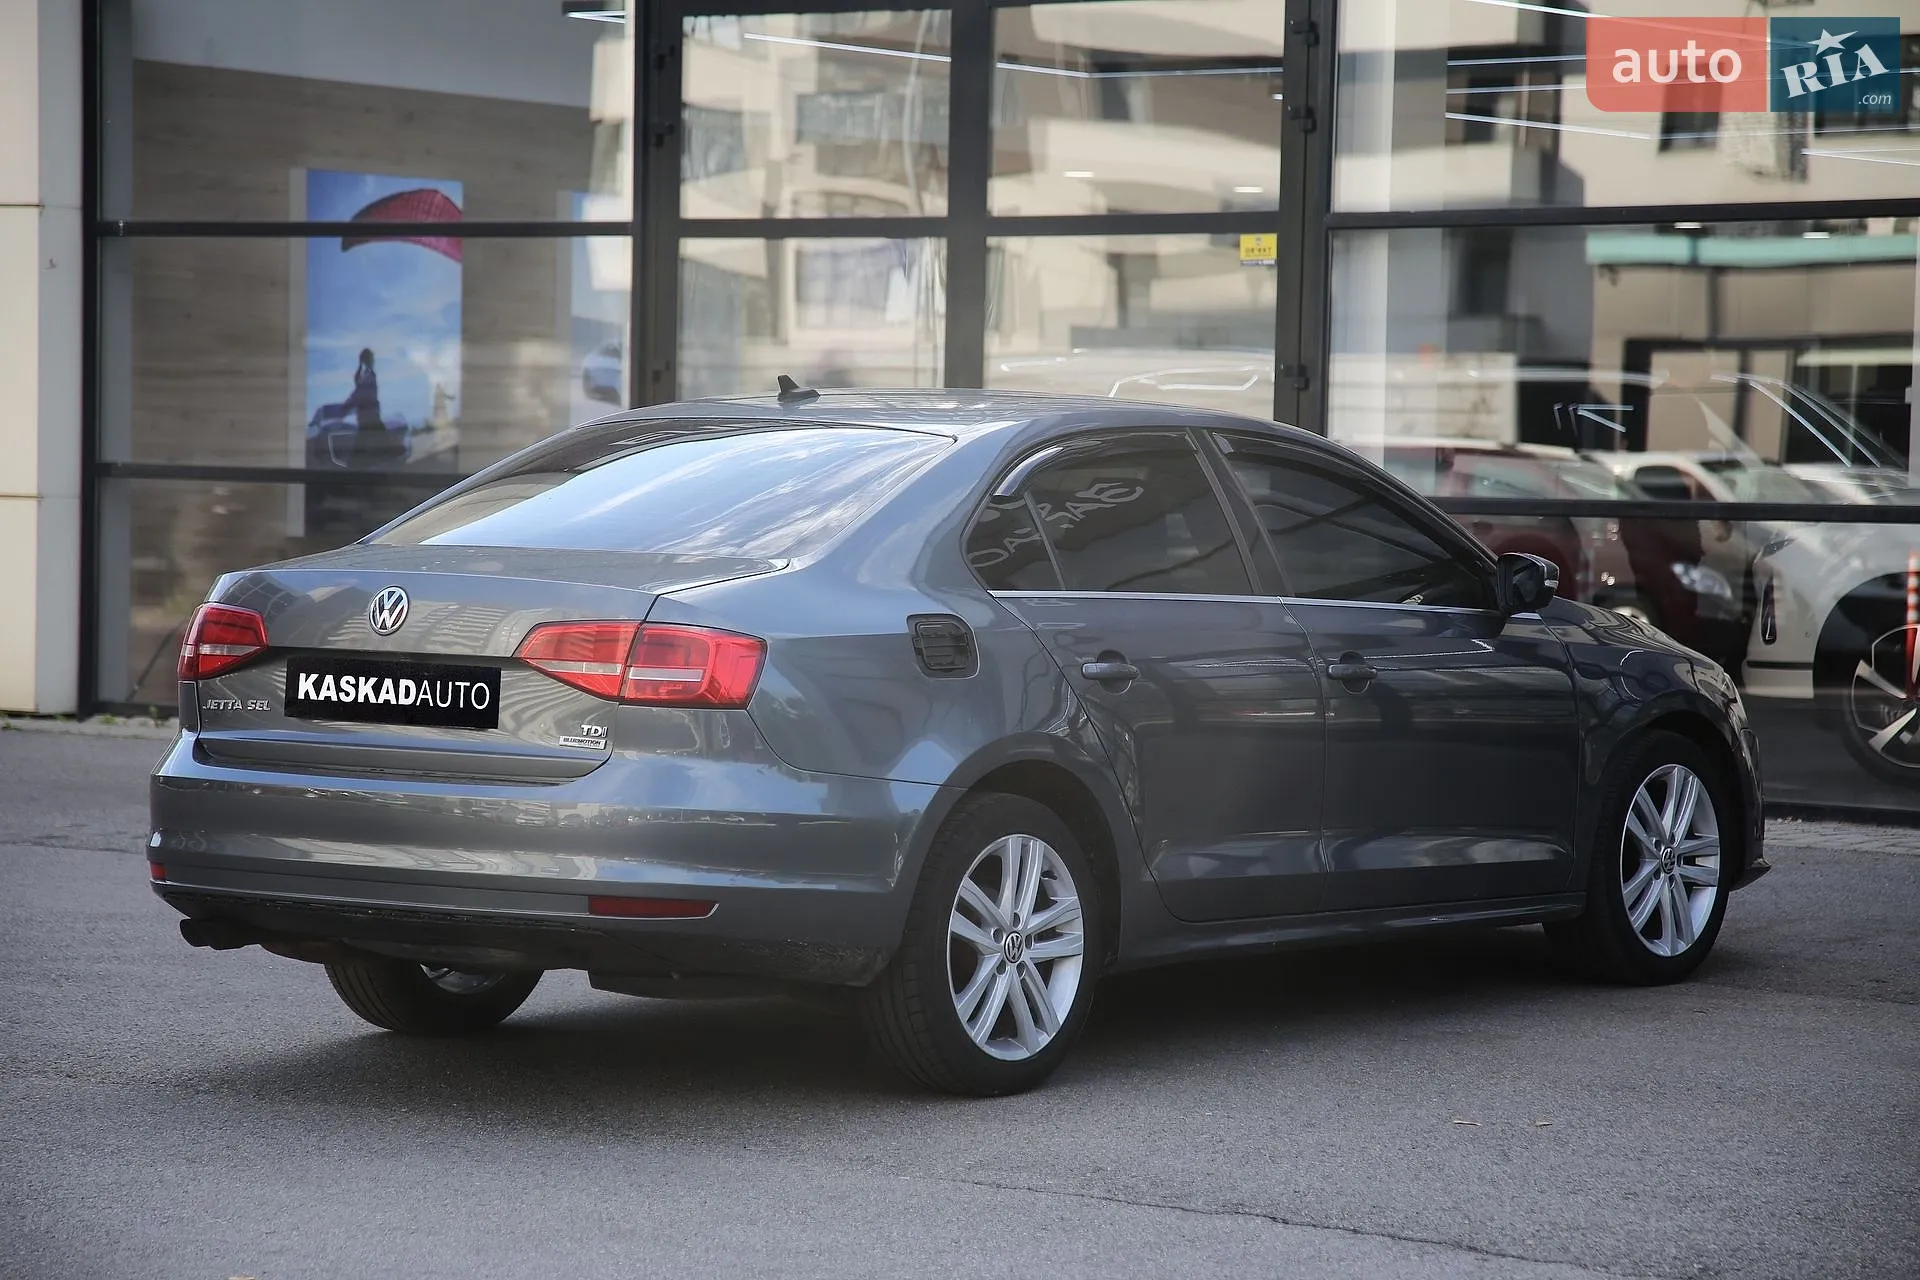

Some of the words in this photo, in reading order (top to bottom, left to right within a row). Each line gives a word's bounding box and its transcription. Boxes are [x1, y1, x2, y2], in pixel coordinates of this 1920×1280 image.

[297, 672, 491, 710] KASKADAUTO
[202, 698, 243, 711] JETTA
[247, 699, 272, 711] SEL
[580, 723, 608, 738] TDI
